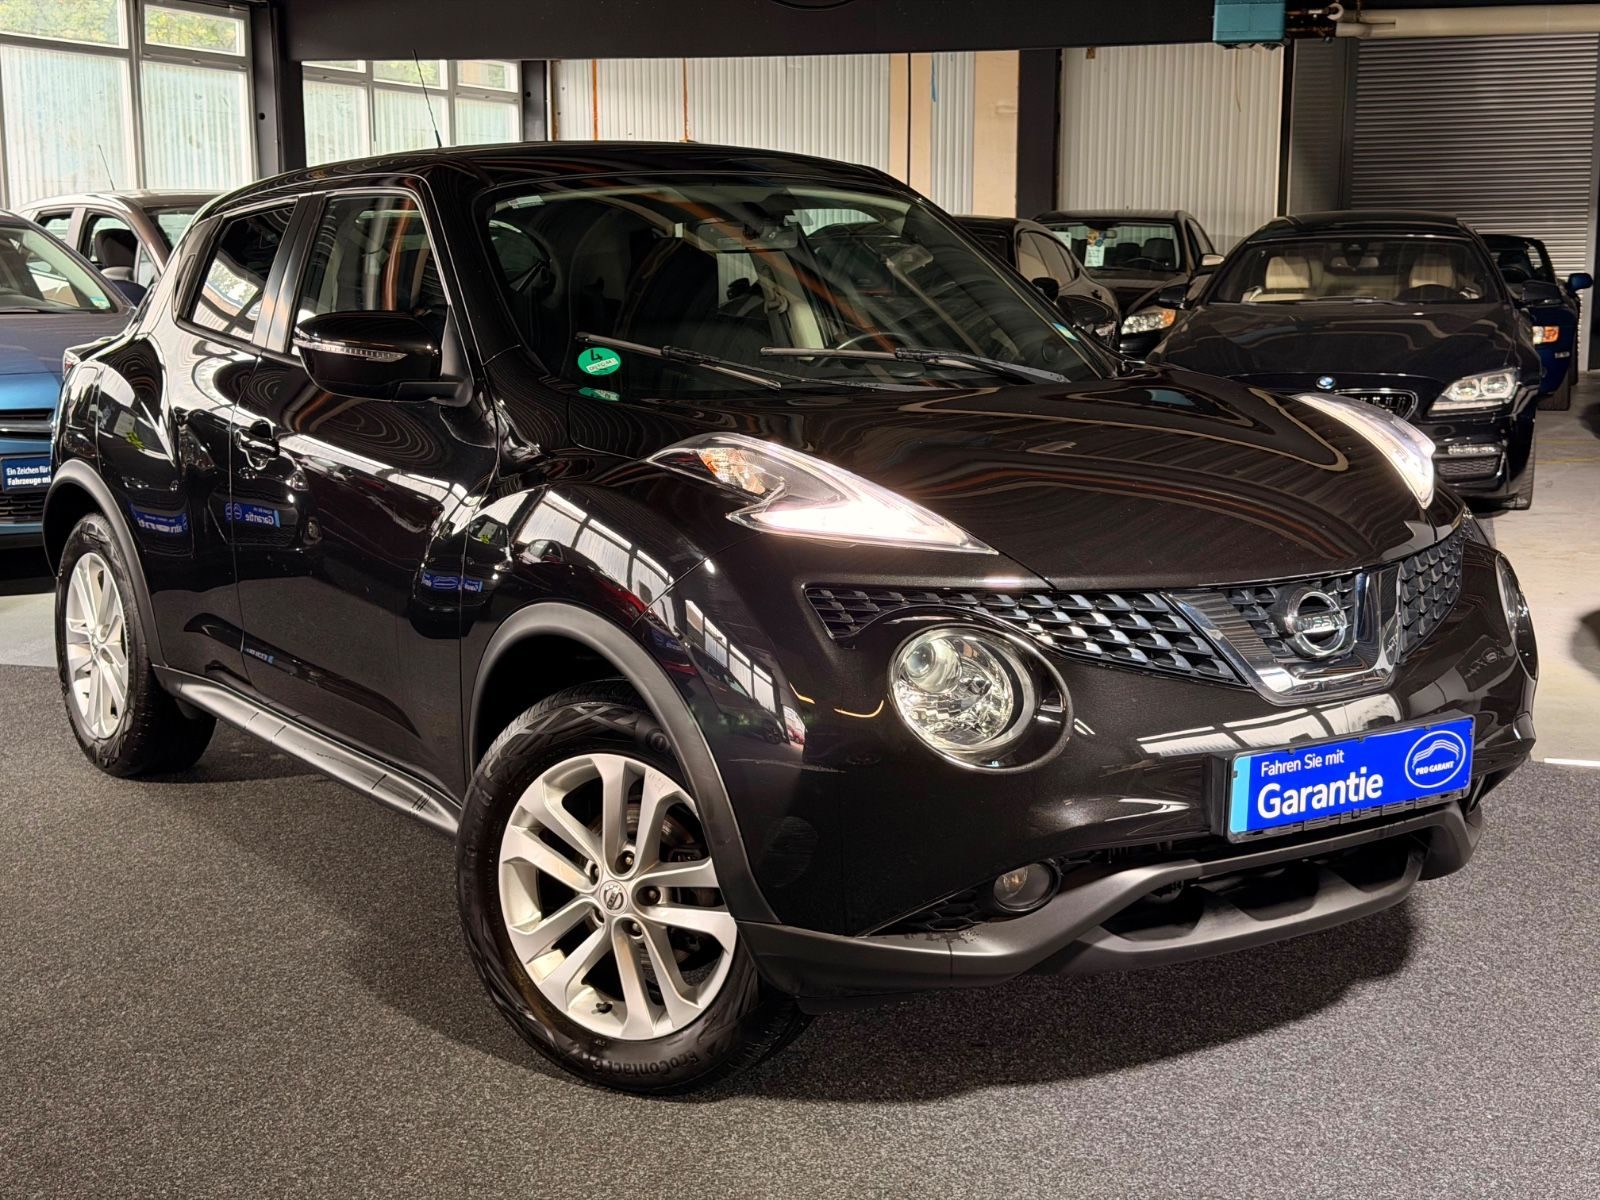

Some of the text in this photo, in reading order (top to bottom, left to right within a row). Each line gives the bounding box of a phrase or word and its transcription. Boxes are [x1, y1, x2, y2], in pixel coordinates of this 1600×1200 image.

[6, 467, 17, 476] Ein
[16, 466, 40, 475] Zeichen
[7, 477, 42, 486] Fahrzeuge
[1260, 749, 1345, 777] Fahren Sie mit
[1415, 760, 1455, 776] PRO GARANT
[1257, 766, 1384, 819] Garantie
[607, 1051, 698, 1077] EcoContact
